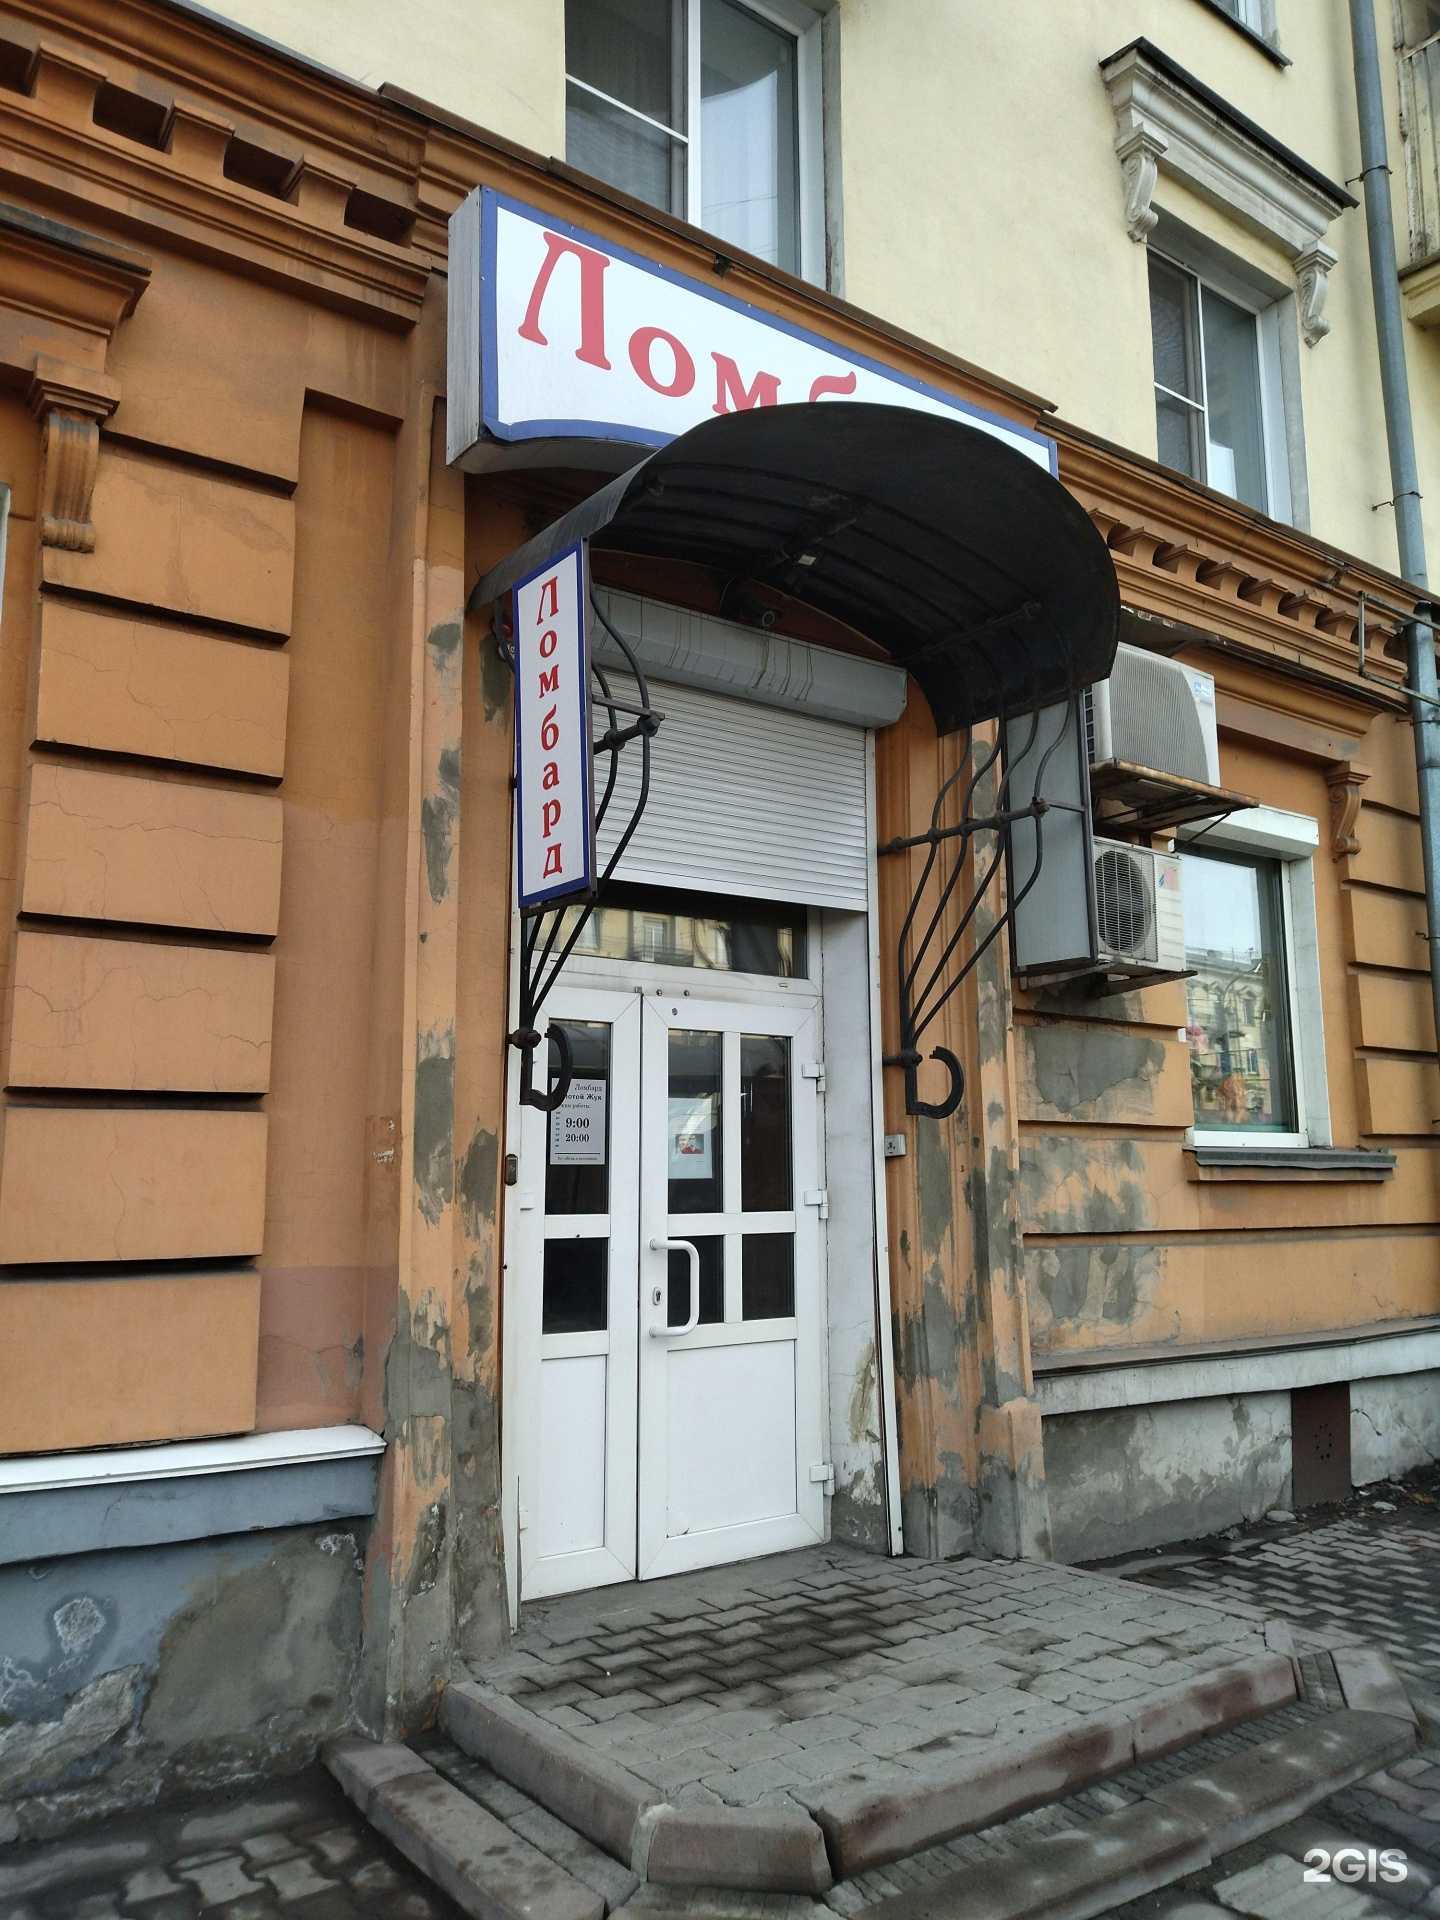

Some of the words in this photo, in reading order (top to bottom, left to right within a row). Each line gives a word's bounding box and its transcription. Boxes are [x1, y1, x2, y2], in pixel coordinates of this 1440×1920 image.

[536, 575, 563, 879] Ломбард
[586, 1093, 602, 1101] Жук
[565, 1117, 590, 1128] 9:00
[565, 1133, 590, 1142] 20:00
